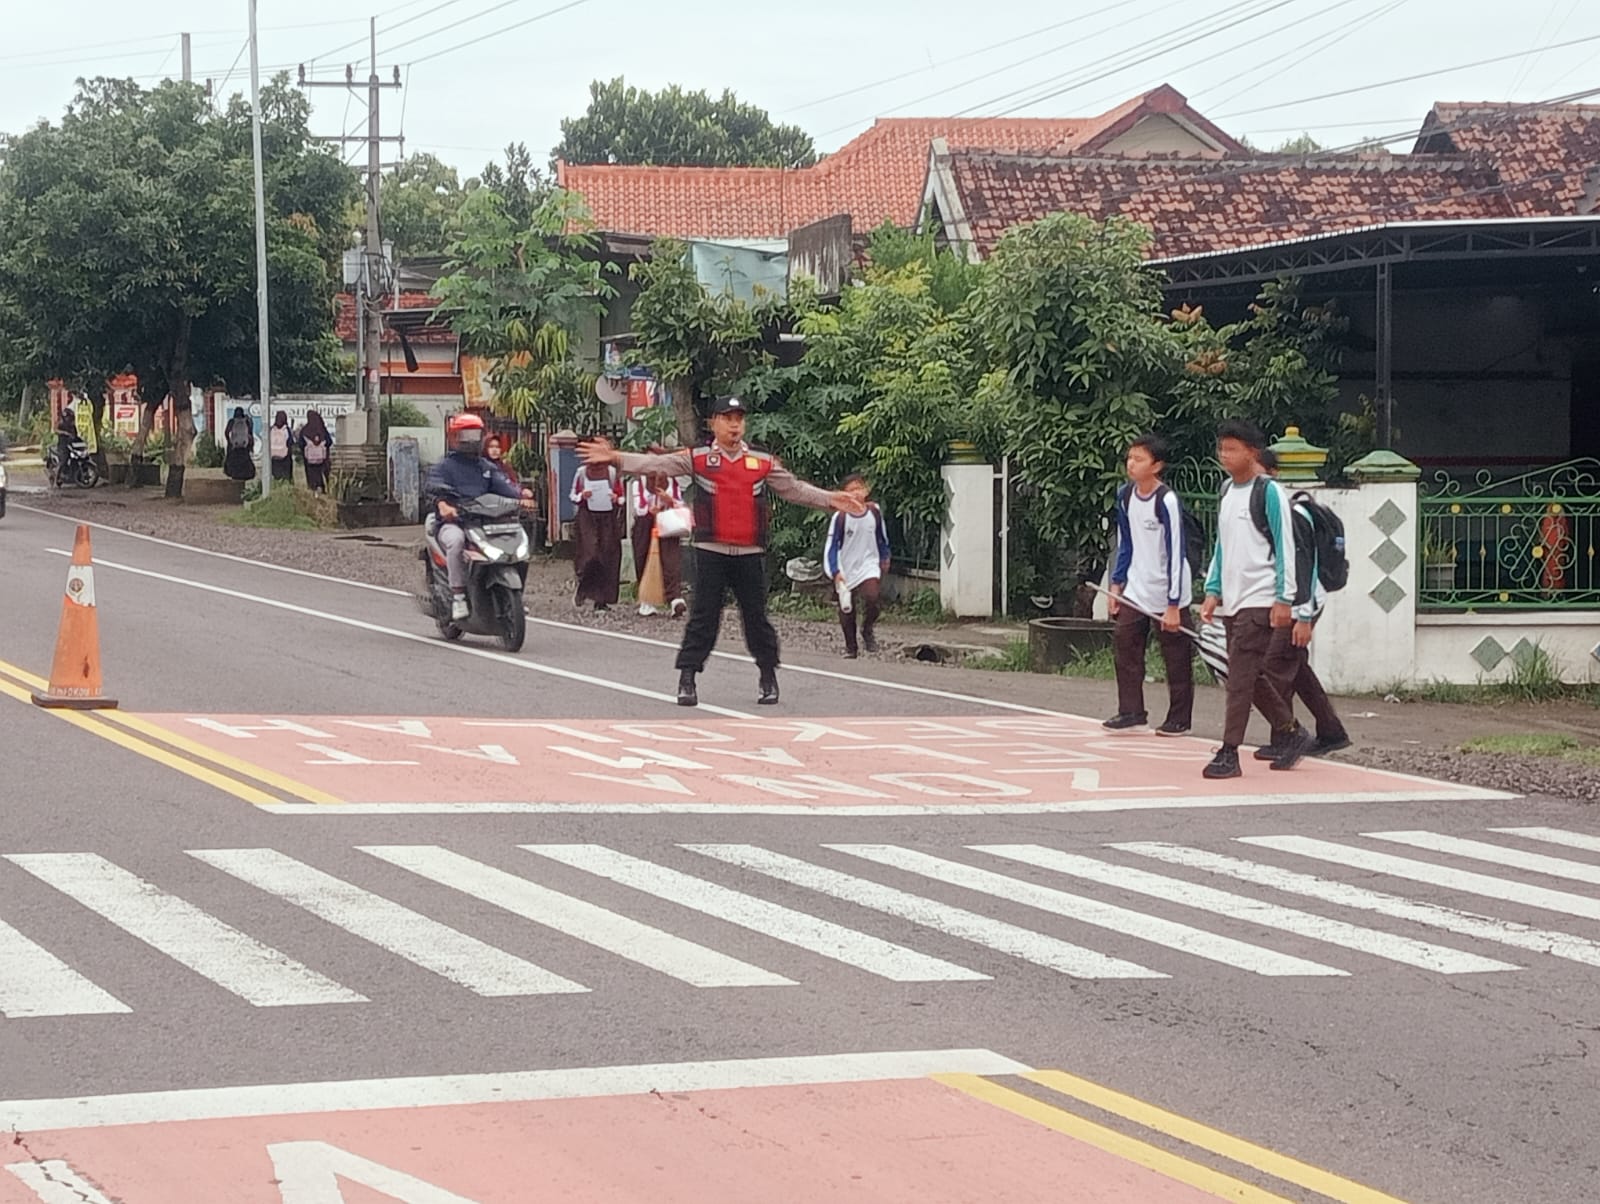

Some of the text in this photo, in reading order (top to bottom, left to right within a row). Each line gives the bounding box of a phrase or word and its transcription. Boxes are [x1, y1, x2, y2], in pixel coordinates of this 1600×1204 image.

[184, 718, 1107, 742] SEKOLAH
[296, 742, 1214, 770] SELAMAT
[568, 768, 1183, 798] ZONA
